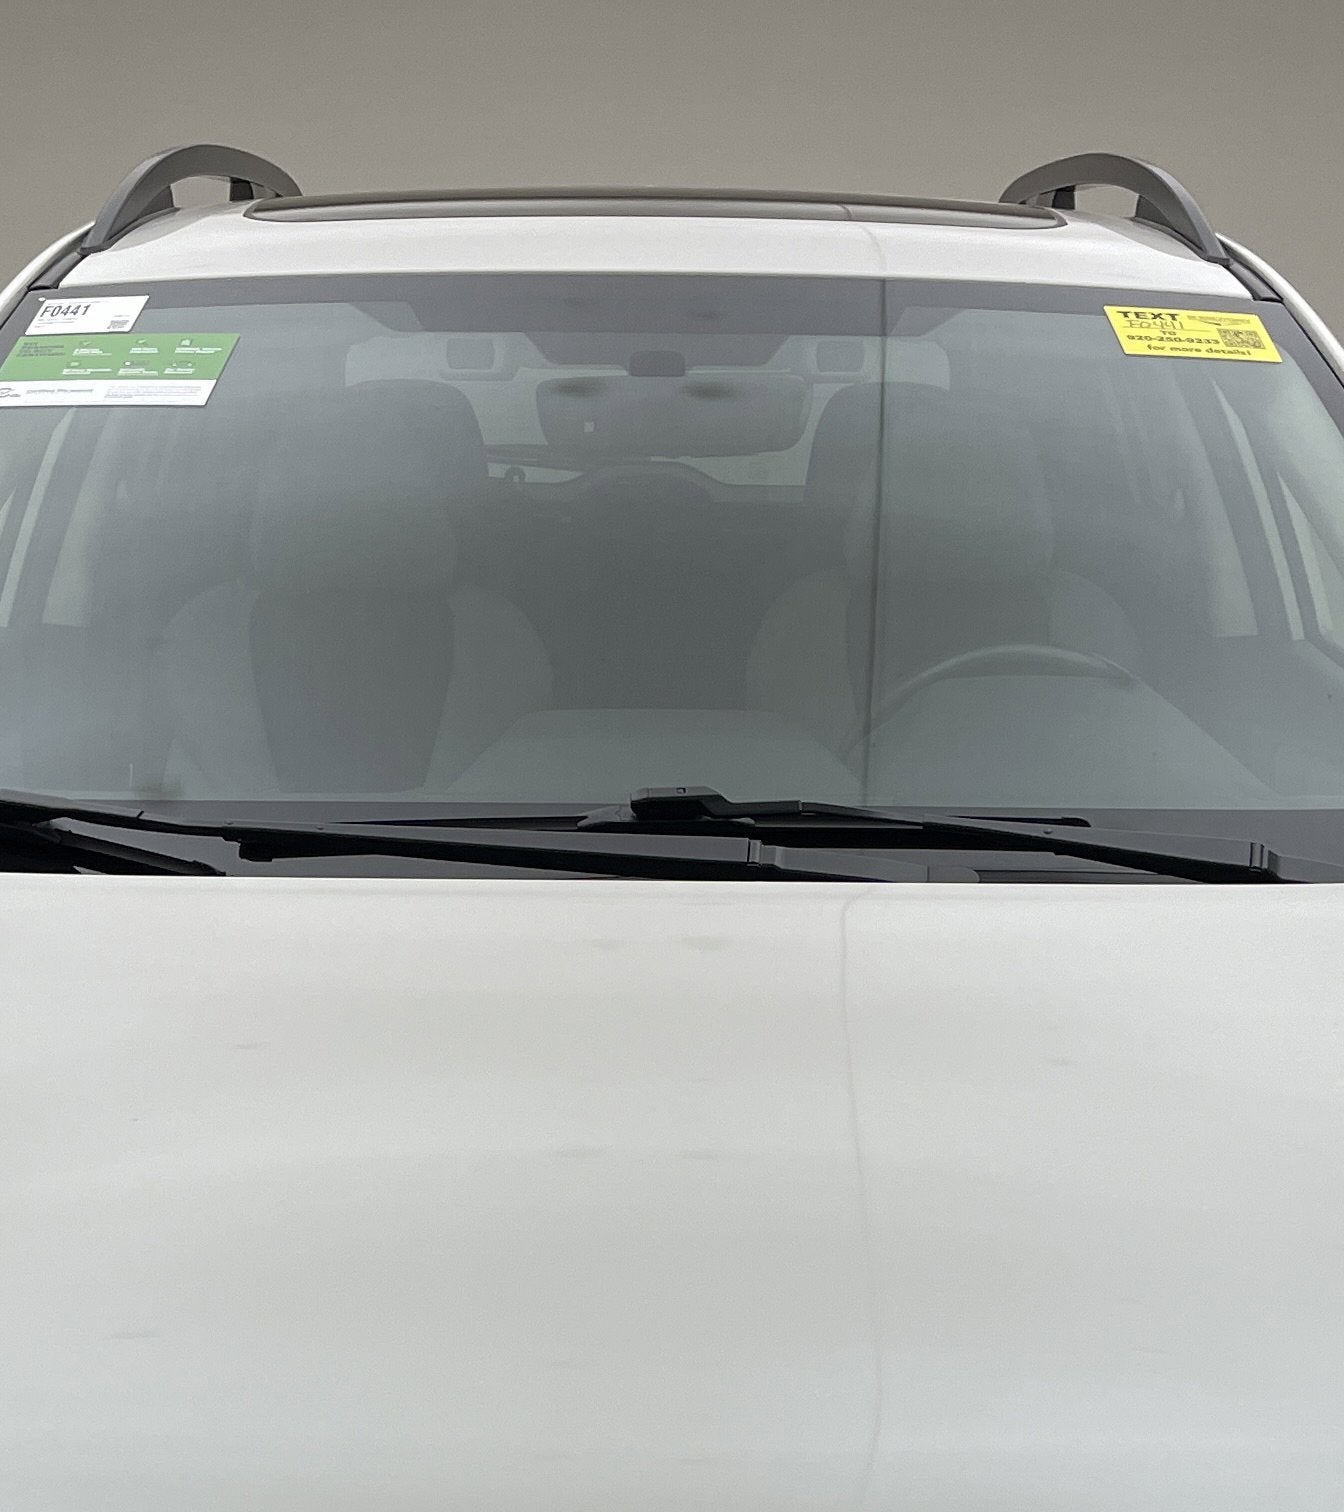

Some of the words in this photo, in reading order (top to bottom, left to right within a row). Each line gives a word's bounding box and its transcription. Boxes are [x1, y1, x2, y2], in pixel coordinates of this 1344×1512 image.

[39, 304, 91, 318] F0441
[1117, 311, 1180, 321] TEXT
[1147, 344, 1165, 352] for
